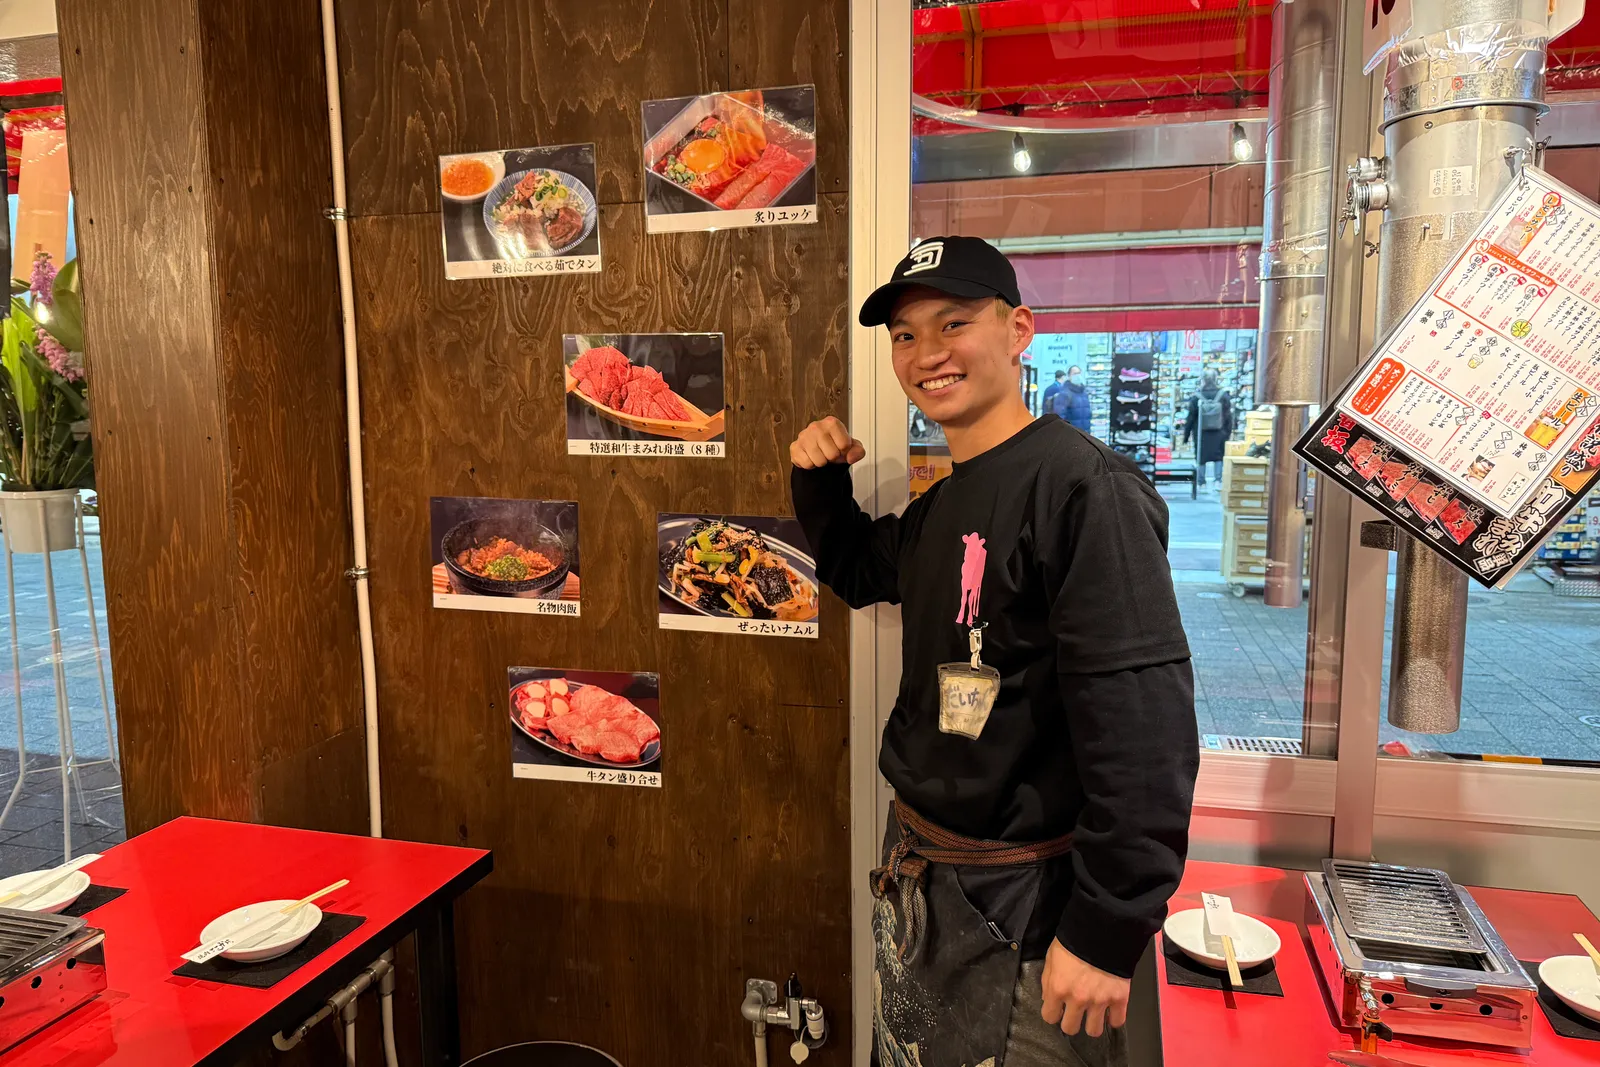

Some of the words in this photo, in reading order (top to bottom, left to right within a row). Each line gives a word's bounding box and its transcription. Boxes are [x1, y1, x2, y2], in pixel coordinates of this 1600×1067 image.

[754, 207, 813, 223] 炙りユッケ
[1519, 196, 1555, 240] レモンサワー
[491, 257, 598, 274] 絶対に食べる茹でタン
[1524, 370, 1549, 398] 生ビール小
[1526, 376, 1561, 414] ごっつい生ビール
[1437, 403, 1460, 428] ウーロン茶
[1546, 399, 1562, 417] 580
[1551, 391, 1584, 427] 生ビール
[1511, 441, 1527, 458] 梅酒
[536, 601, 577, 614] 名物肉飯
[737, 620, 815, 635] ぜったいナムル
[586, 770, 659, 785] 牛タン盛り合せ
